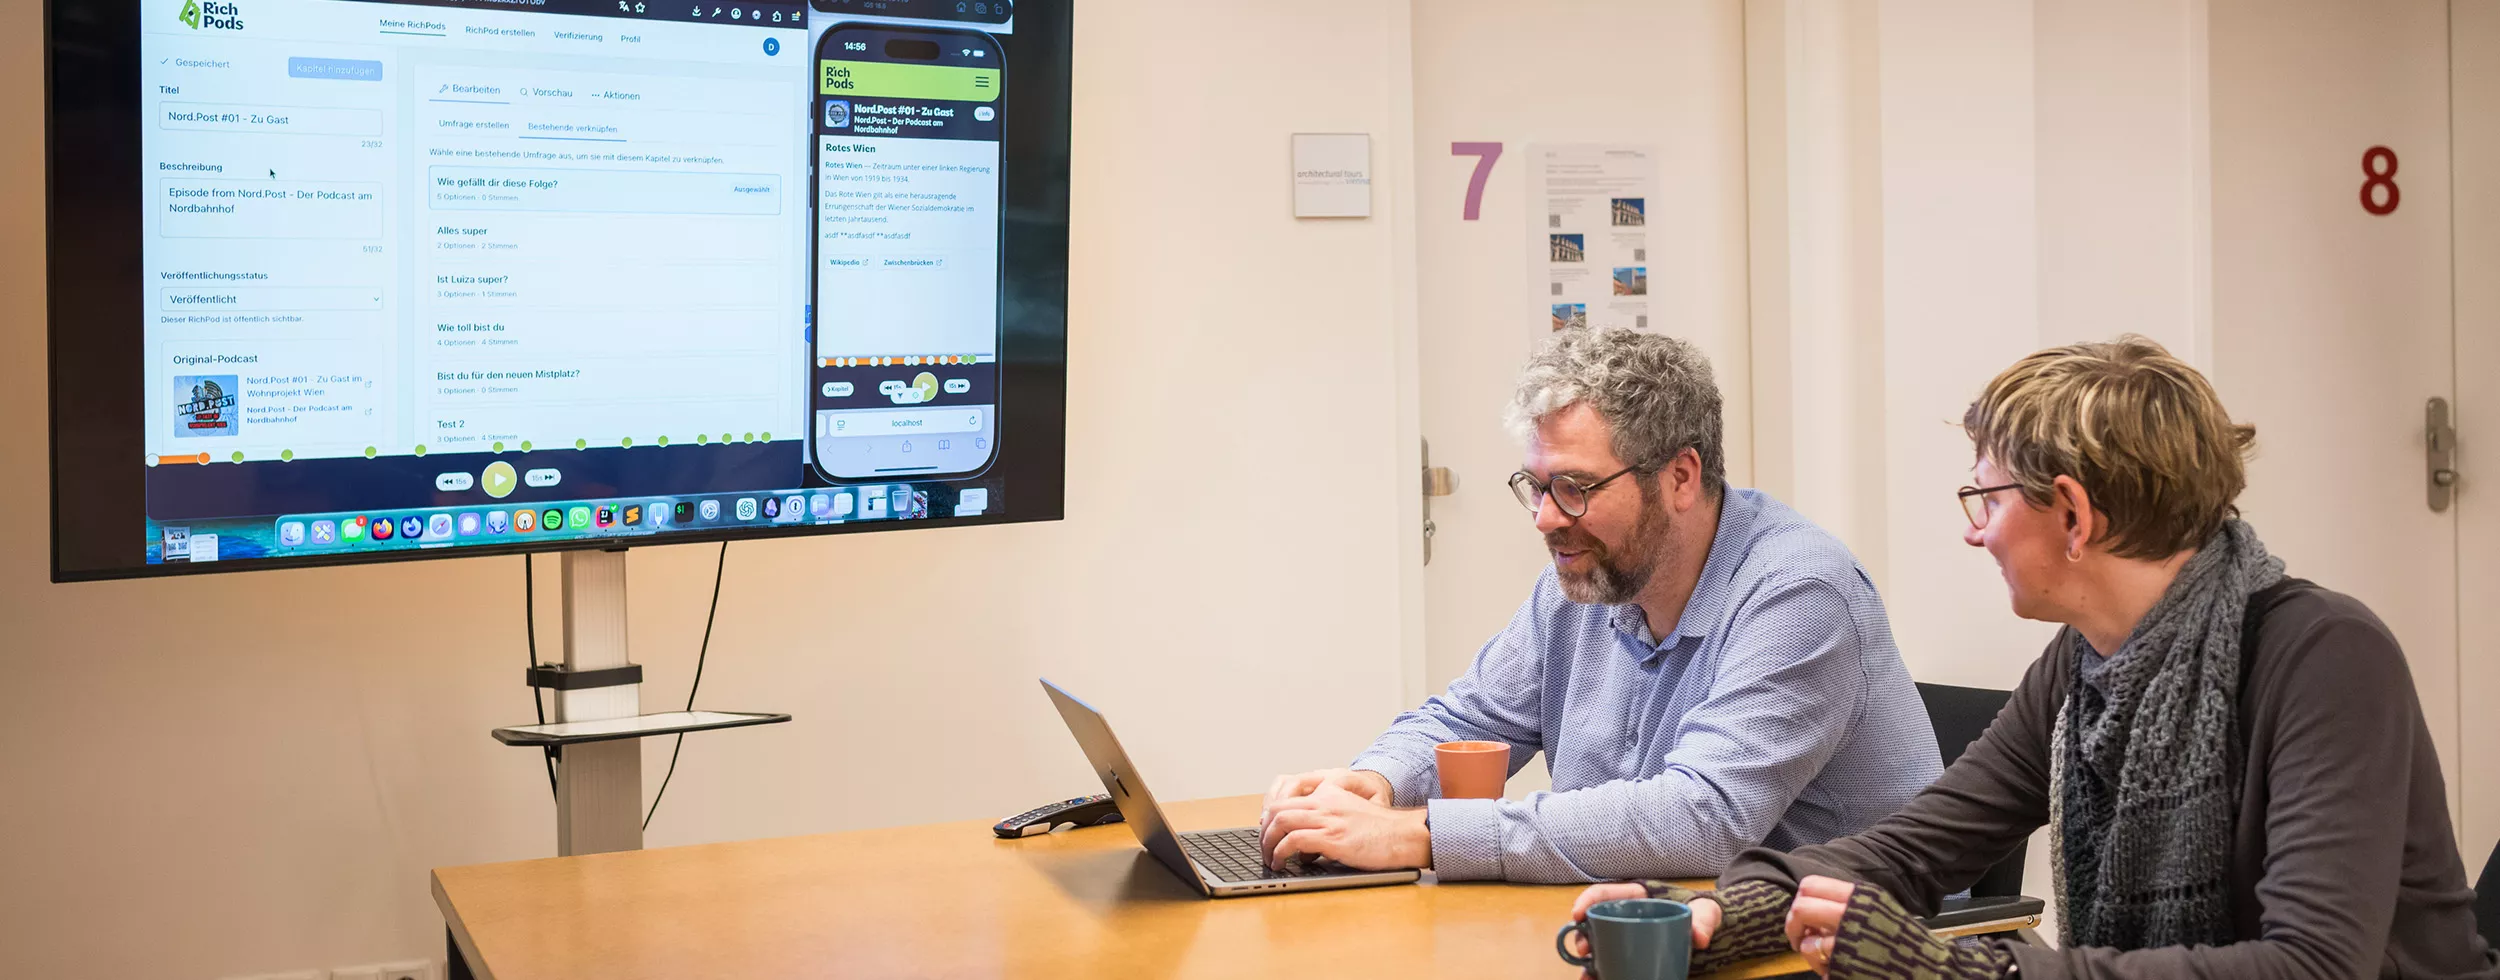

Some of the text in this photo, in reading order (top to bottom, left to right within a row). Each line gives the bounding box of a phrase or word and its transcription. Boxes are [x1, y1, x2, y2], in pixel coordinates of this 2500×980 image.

[203, 2, 238, 16] Rich
[203, 16, 244, 31] Pods
[380, 19, 446, 31] Meine RichPods
[465, 26, 535, 37] RichPod erstellen
[554, 31, 603, 42] Verifizierung
[621, 35, 641, 44] Profil
[844, 42, 866, 51] 14:56
[175, 58, 230, 69] Gespeichert
[296, 64, 326, 74] Kapitel
[826, 67, 850, 77] Rich
[826, 78, 854, 89] Pods
[159, 86, 180, 95] Titel
[453, 84, 501, 95] Bearbeiten
[533, 88, 573, 97] Vorschau
[603, 91, 640, 100] Aktionen
[854, 104, 897, 115] Nord.Post
[898, 106, 914, 116] #01
[921, 107, 932, 116] Zu
[933, 108, 954, 117] Gast
[168, 112, 289, 125] Nord.Post #01 Zu Gast
[854, 117, 887, 125] Nord.Post
[905, 119, 931, 127] Podcast
[439, 120, 510, 130] Umfrage erstellen
[528, 122, 574, 132] Bestehende
[854, 126, 898, 134] Nordbahnhof
[361, 140, 383, 148] 23/32
[825, 144, 876, 153] Rotes Wien
[475, 150, 521, 158] bestehende
[523, 152, 556, 160] Umfrage
[603, 153, 615, 161] mit
[617, 154, 643, 162] diesem
[645, 155, 670, 163] Kapitel
[159, 162, 223, 172] Beschreibung
[960, 166, 990, 174] Regierung
[1297, 170, 1363, 178] architectural tours
[437, 178, 558, 190] Wie gefällt dir diese Folge?
[1451, 142, 1503, 220] 7
[2360, 146, 2400, 216] 8
[169, 188, 209, 199] Episode
[212, 189, 235, 198] from
[238, 189, 286, 199] Nord.Post
[297, 190, 314, 199] Der
[317, 191, 355, 200] Podcast
[444, 194, 476, 202] Optionen
[873, 192, 884, 200] gilt
[910, 193, 956, 201] herausragende
[169, 203, 235, 214] Nordbahnhof
[825, 203, 876, 212] Errungenschaft
[437, 227, 488, 237] Alles super
[161, 272, 268, 281] Veröffentlichungsstatus
[451, 276, 475, 284] Luiza
[478, 276, 508, 286] super?
[170, 294, 237, 304] Veröffentlicht
[443, 291, 476, 299] Optionen
[161, 315, 304, 324] Dieser RichPod ist öffentlich sichtbar.
[437, 323, 505, 332] Wie toll bist du
[444, 339, 476, 347] Optionen
[173, 355, 258, 365] Original-Podcast
[247, 376, 290, 385] Nord.Post
[291, 376, 308, 384] #01
[330, 375, 350, 383] Gast
[352, 375, 362, 383] im
[437, 372, 454, 380] Bist
[457, 372, 469, 380] du
[471, 371, 484, 380] für
[486, 371, 504, 379] den
[535, 370, 580, 380] Mistplatz?
[247, 388, 325, 398] Wohnprojekt Wien
[488, 386, 518, 394] Stimmen
[293, 405, 307, 413] Der
[309, 404, 339, 412] Podcast
[247, 416, 297, 425] Nordbahnhof
[437, 420, 465, 429] Test 2
[488, 433, 518, 441] Stimmen
